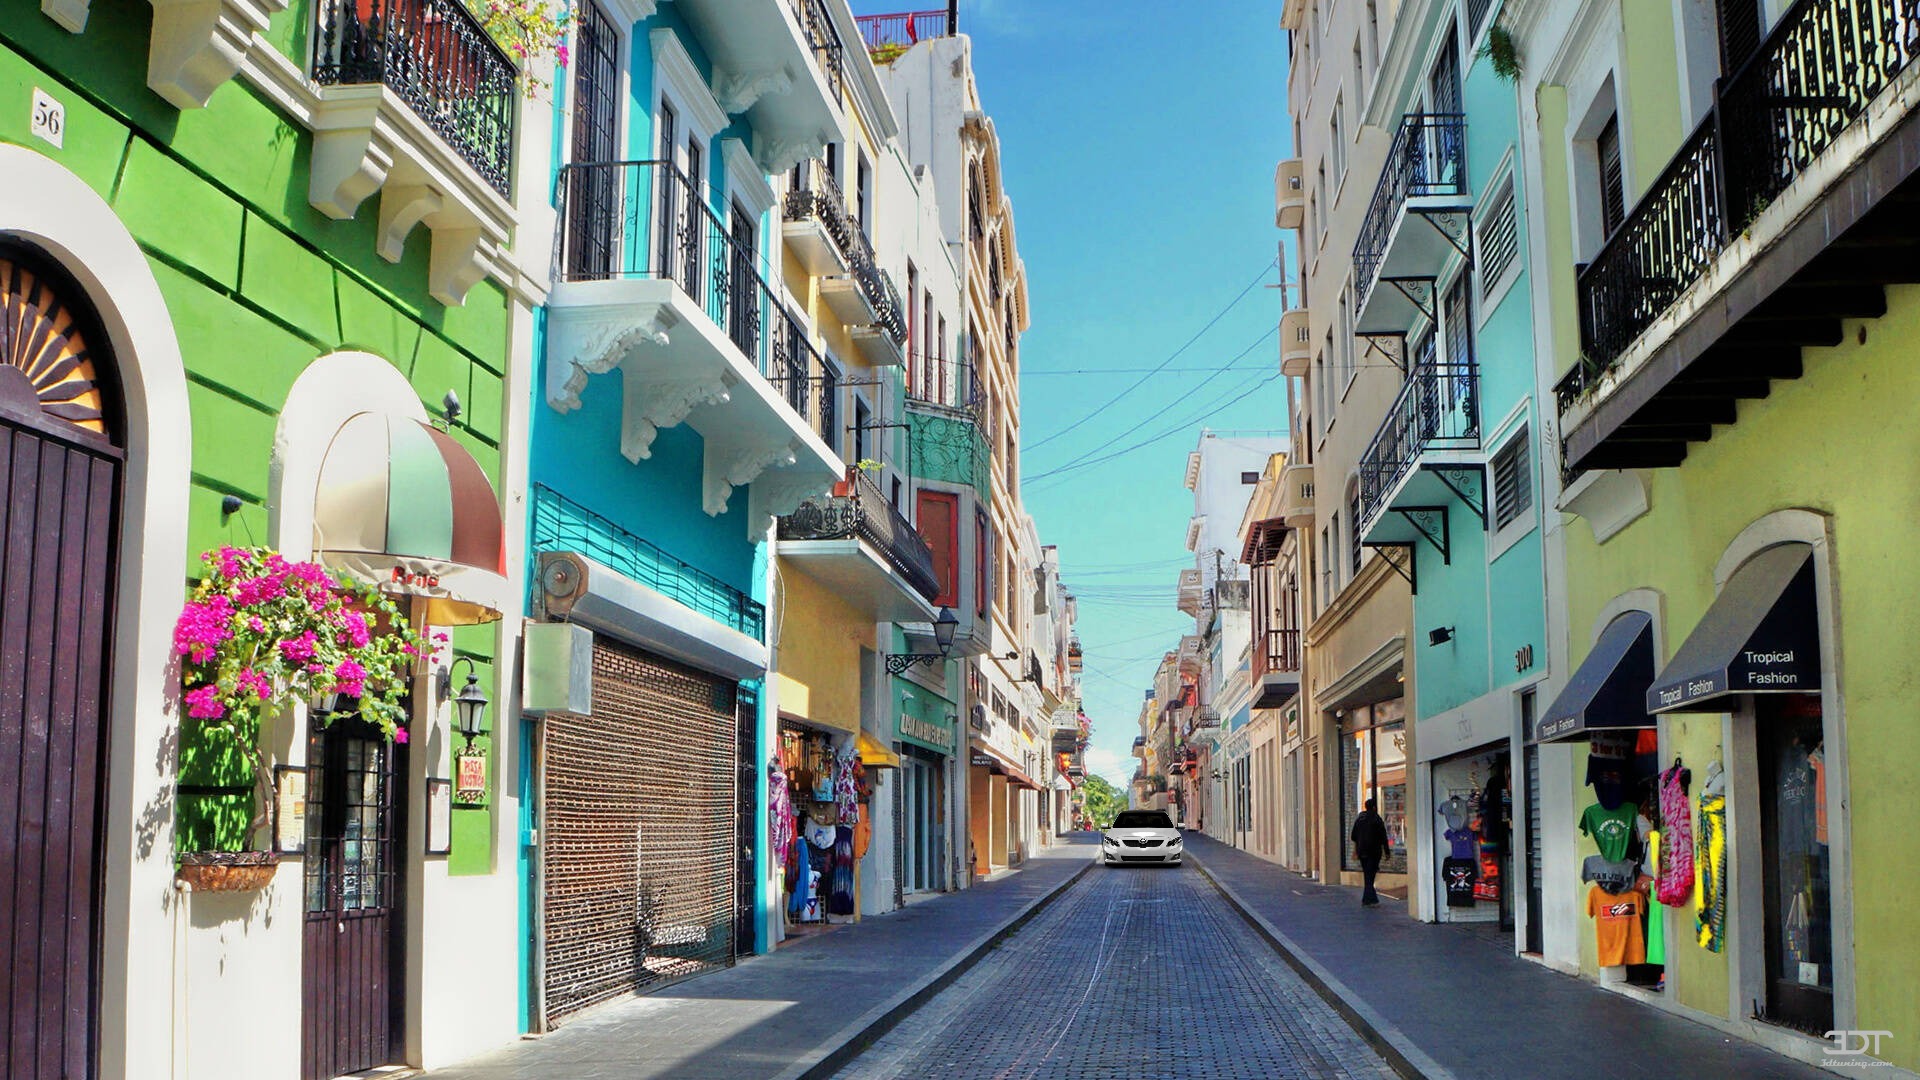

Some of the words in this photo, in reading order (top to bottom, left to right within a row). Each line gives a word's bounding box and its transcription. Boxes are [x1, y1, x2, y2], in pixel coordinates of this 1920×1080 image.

[34, 100, 60, 135] 56
[1514, 644, 1533, 673] 300
[1745, 651, 1794, 665] Tropical
[1748, 672, 1797, 684] Fashion
[1659, 685, 1683, 704] Tropical
[1688, 680, 1714, 697] Fashion
